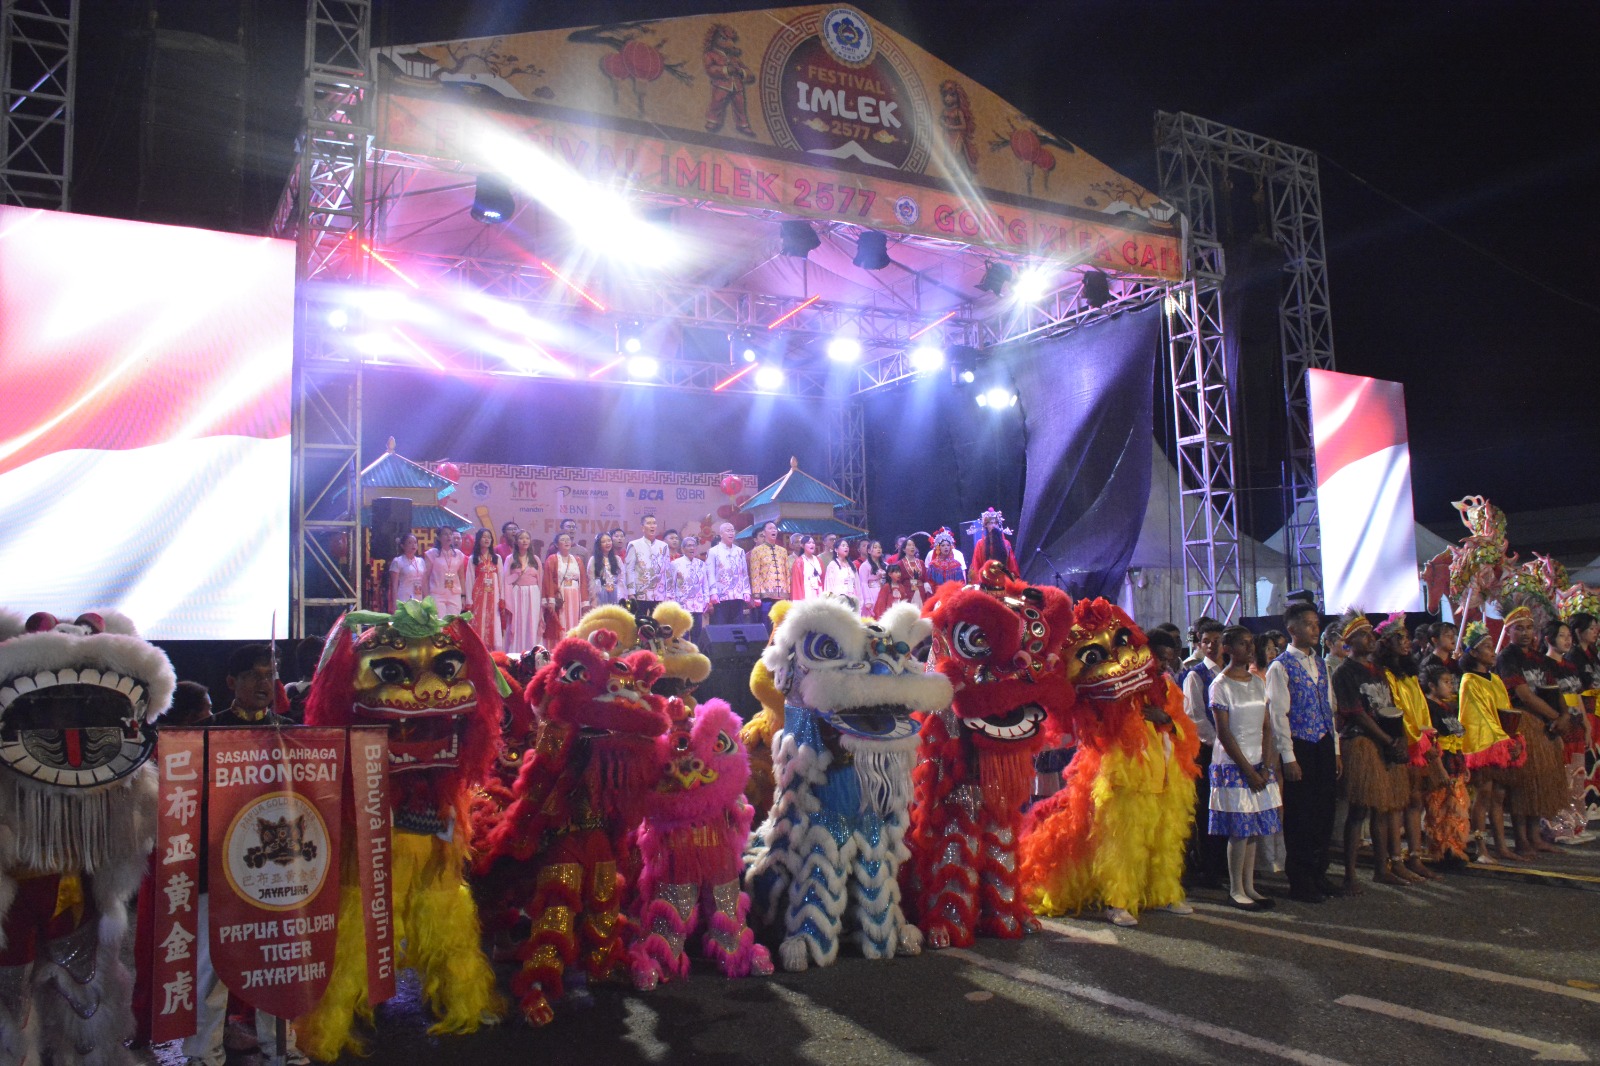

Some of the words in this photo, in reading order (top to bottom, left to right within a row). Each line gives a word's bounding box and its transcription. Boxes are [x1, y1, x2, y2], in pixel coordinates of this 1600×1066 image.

[808, 65, 885, 95] FESTIVAL
[797, 81, 902, 129] IMLEK
[831, 120, 871, 141] 2577
[660, 155, 780, 202] IMLEK
[793, 178, 877, 217] 2577
[934, 204, 1028, 246] GONG
[1039, 223, 1068, 251] XI
[518, 481, 538, 499] PTC
[572, 489, 589, 497] BANK
[639, 488, 664, 500] BCA
[688, 489, 705, 500] BRI
[569, 506, 588, 515] BNI
[544, 519, 634, 535] FTIVAL
[216, 749, 269, 764] SASANA
[271, 748, 337, 761] OLAHRAGA
[215, 762, 337, 788] BARONGSAI
[258, 885, 310, 900] JAYAPURA
[219, 921, 279, 943] PAPUA
[282, 913, 335, 937] GOLDEN
[259, 940, 312, 962] TIGER
[241, 961, 327, 989] JAYAPURA
